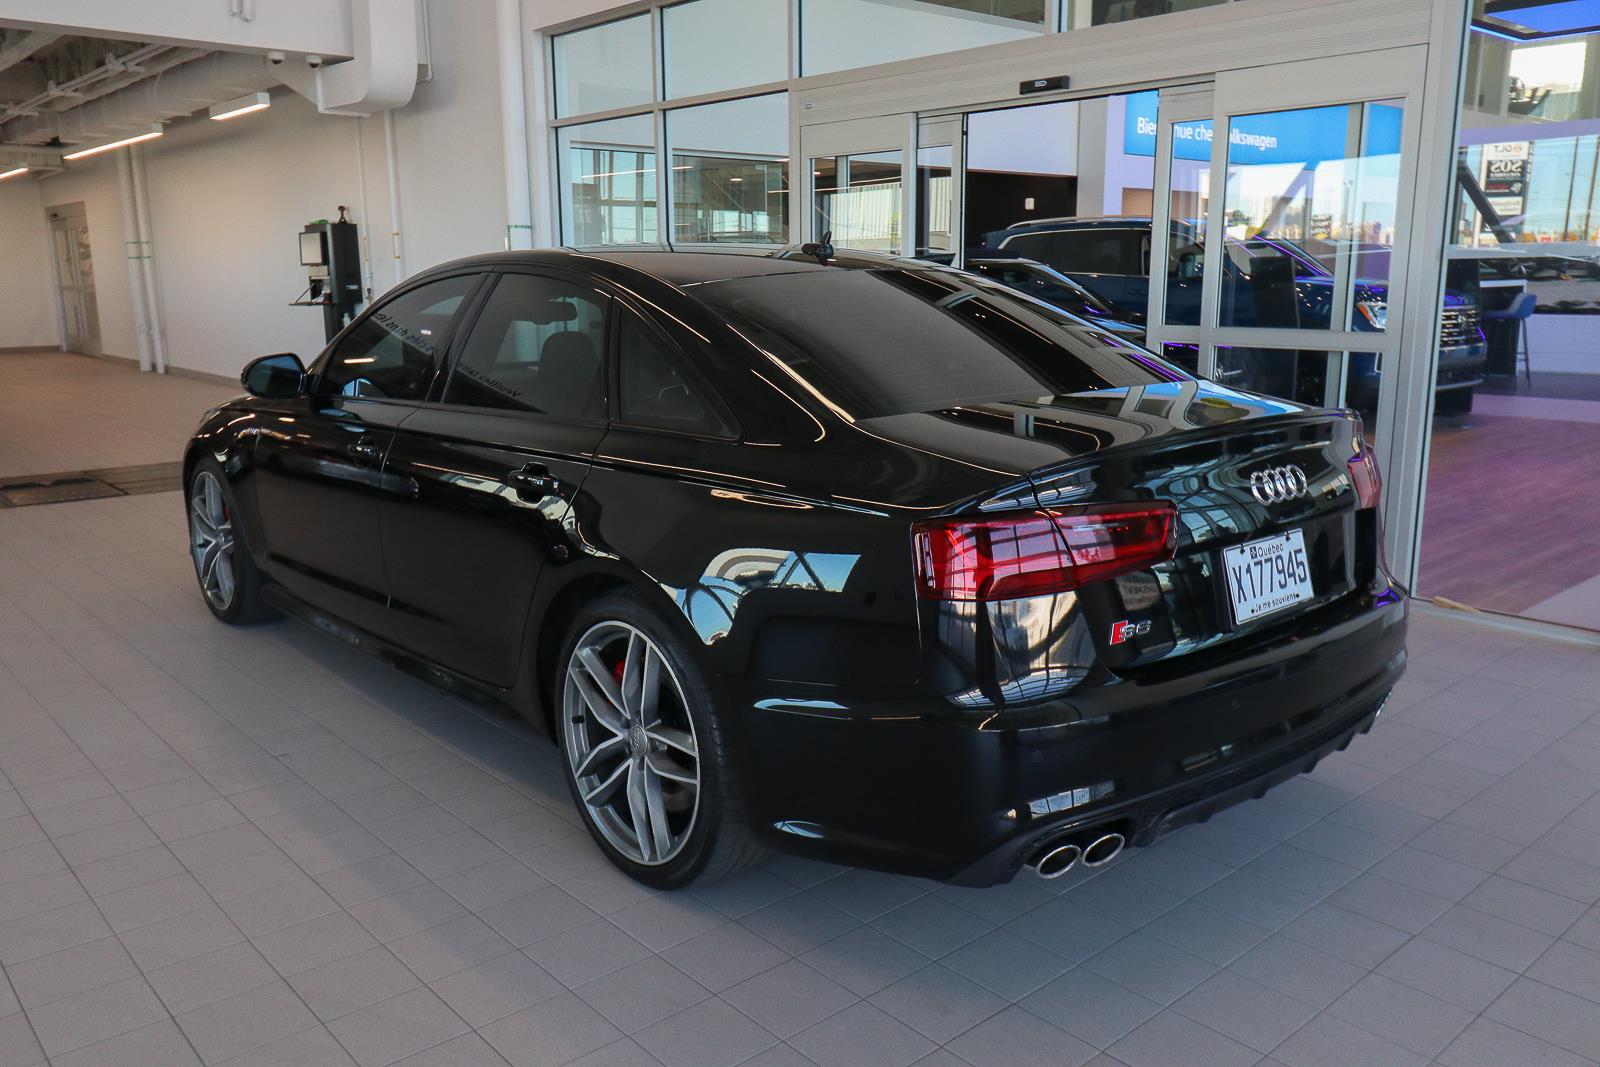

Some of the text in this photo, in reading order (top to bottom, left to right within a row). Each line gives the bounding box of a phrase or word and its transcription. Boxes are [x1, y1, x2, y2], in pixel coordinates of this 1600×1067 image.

[1137, 116, 1277, 151] Bienue che lkswagen
[1257, 543, 1284, 558] Québec
[1232, 547, 1307, 604] X177945
[1262, 600, 1271, 608] me
[1272, 593, 1297, 607] souviens
[1118, 620, 1152, 640] S6
